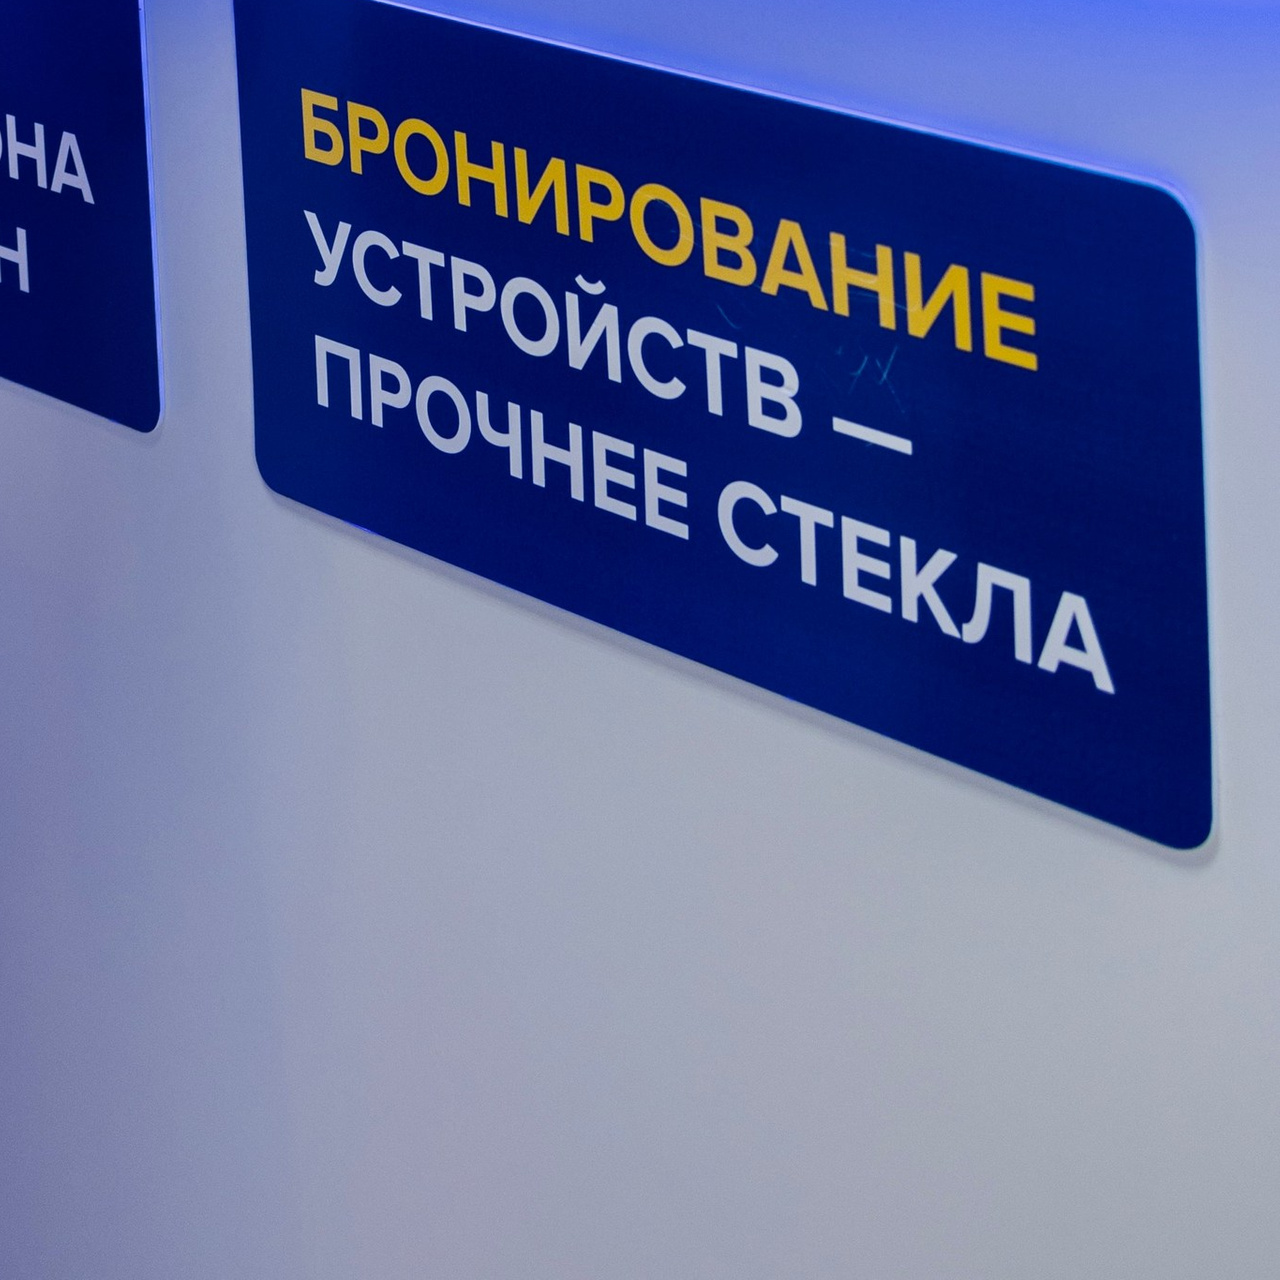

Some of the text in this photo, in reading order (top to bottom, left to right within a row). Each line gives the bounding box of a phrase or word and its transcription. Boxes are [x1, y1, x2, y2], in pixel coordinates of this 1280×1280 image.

[300, 87, 1039, 372] БРОНИРОВАНИЕ
[303, 209, 803, 439] УСТРОЙСТВ
[314, 333, 1116, 696] ПРОЧНЕЕ СТЕКЛА
